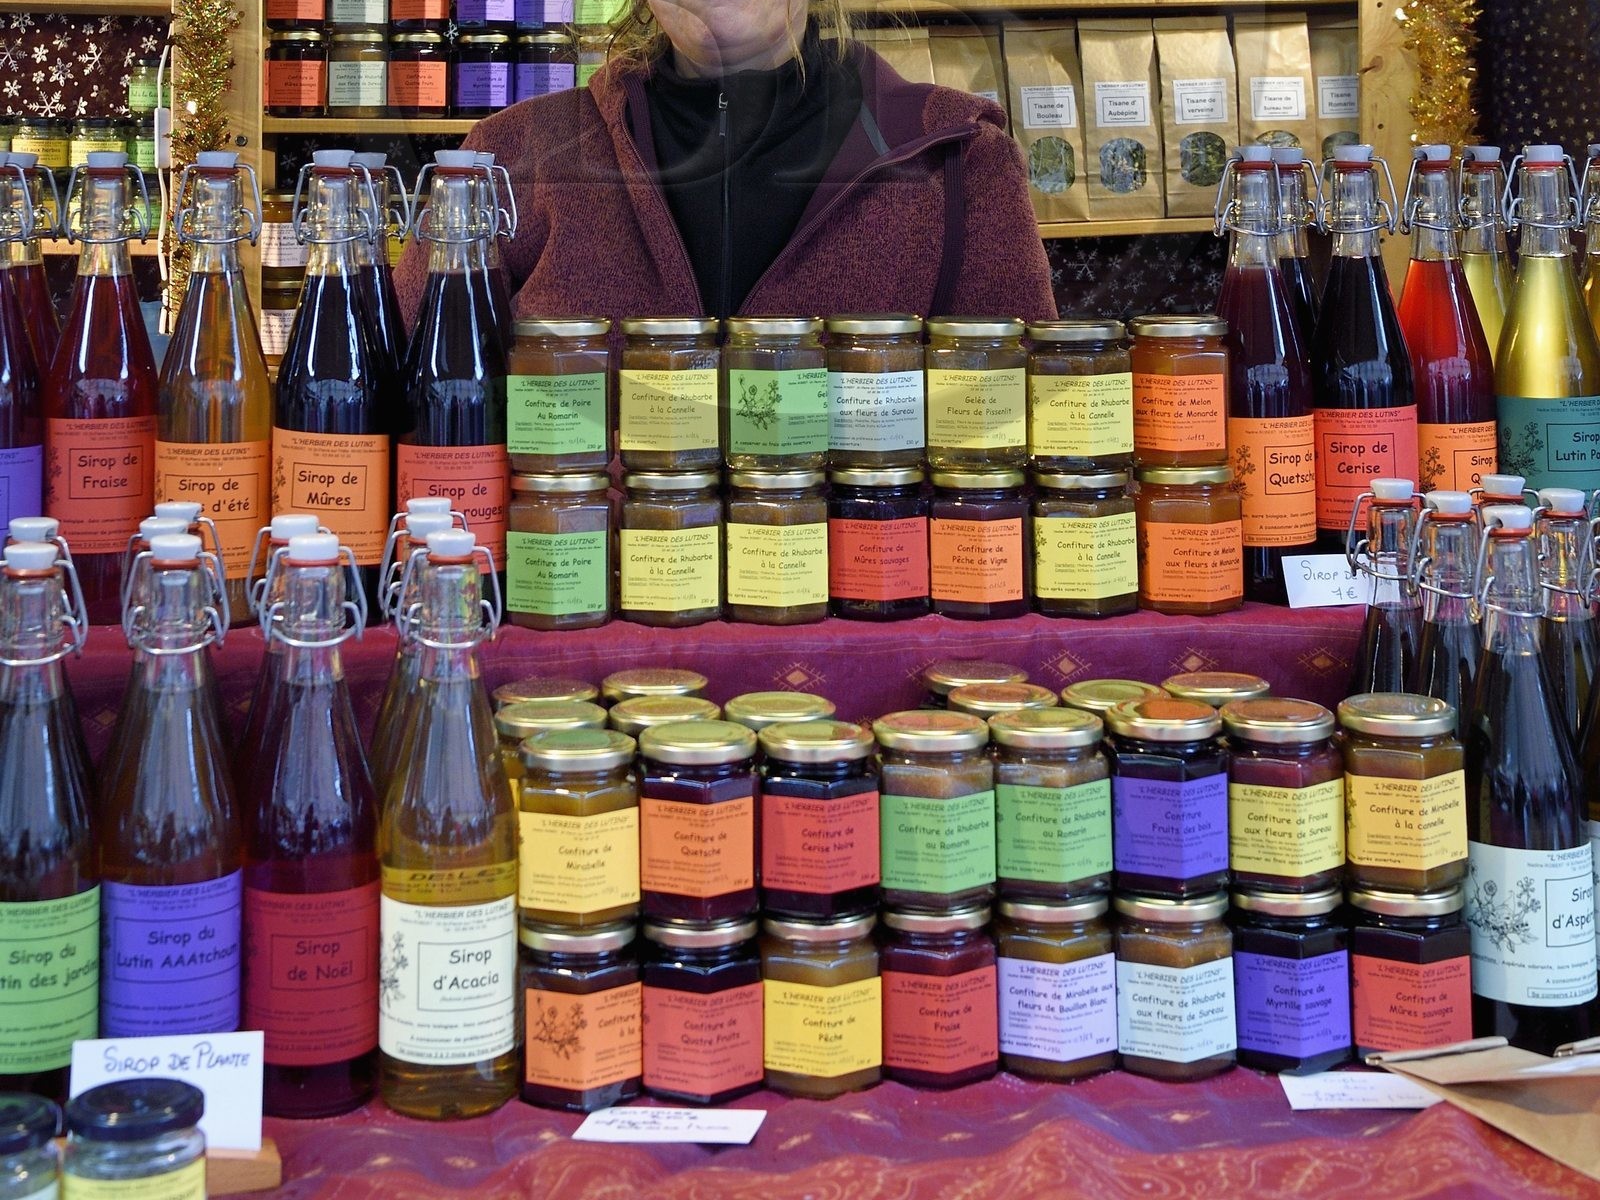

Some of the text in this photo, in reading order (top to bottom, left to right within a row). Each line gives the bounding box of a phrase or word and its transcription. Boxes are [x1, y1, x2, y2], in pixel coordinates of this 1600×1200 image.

[1185, 96, 1216, 105] Tisane de
[1329, 91, 1352, 99] Tisane
[1032, 102, 1065, 110] Tisane de
[1187, 106, 1215, 115] verveine
[1036, 112, 1064, 120] Bouleau
[1107, 109, 1139, 118] Aubépine
[524, 399, 592, 409] Confiture de Poire
[964, 395, 997, 404] Gelée de
[1141, 396, 1212, 407] Confiture de Melon
[537, 411, 580, 421] Au Romarin
[947, 407, 1012, 416] Fleurs de Pissenlit
[1149, 409, 1172, 418] fleurs
[1173, 409, 1183, 418] de
[1185, 409, 1218, 418] Monarde
[1359, 411, 1374, 419] DES
[1572, 431, 1600, 446] Sirop
[1329, 441, 1388, 458] Sirop de
[1555, 448, 1588, 462] Lutin
[77, 454, 138, 469] Sirop de
[1269, 451, 1314, 467] Sirop de
[1471, 454, 1494, 468] Sirop
[1337, 461, 1381, 475] Cerise
[82, 475, 129, 490] Fraise
[178, 478, 239, 493] Sirop de
[297, 470, 358, 488] Sirop de
[306, 491, 351, 507] Mûres
[427, 484, 488, 500] Sirop de
[212, 498, 251, 514] d'été
[463, 504, 503, 521] rouges
[957, 543, 1005, 554] Confiture de
[951, 555, 1009, 567] Pêche de Vigne
[1164, 810, 1202, 821] Confiture
[1247, 811, 1329, 825] Confiture de Fraise
[1151, 822, 1212, 835] Fruits des bois
[1243, 825, 1332, 840] aux fleurs de Sureau
[147, 925, 215, 947] Sirop du
[8, 944, 76, 966] Sirop du
[295, 940, 341, 957] Sirop
[116, 942, 237, 970] Lutin AAAtchoum
[448, 947, 492, 965] Sirop
[287, 961, 353, 982] de Noël
[433, 971, 500, 991] d'Acacia
[918, 1005, 973, 1018] Confiture de
[802, 1015, 856, 1029] Confiture de
[933, 1020, 961, 1033] Fraise
[818, 1030, 844, 1042] Pêche
[103, 1044, 160, 1073] SIROP
[167, 1053, 192, 1071] DE
